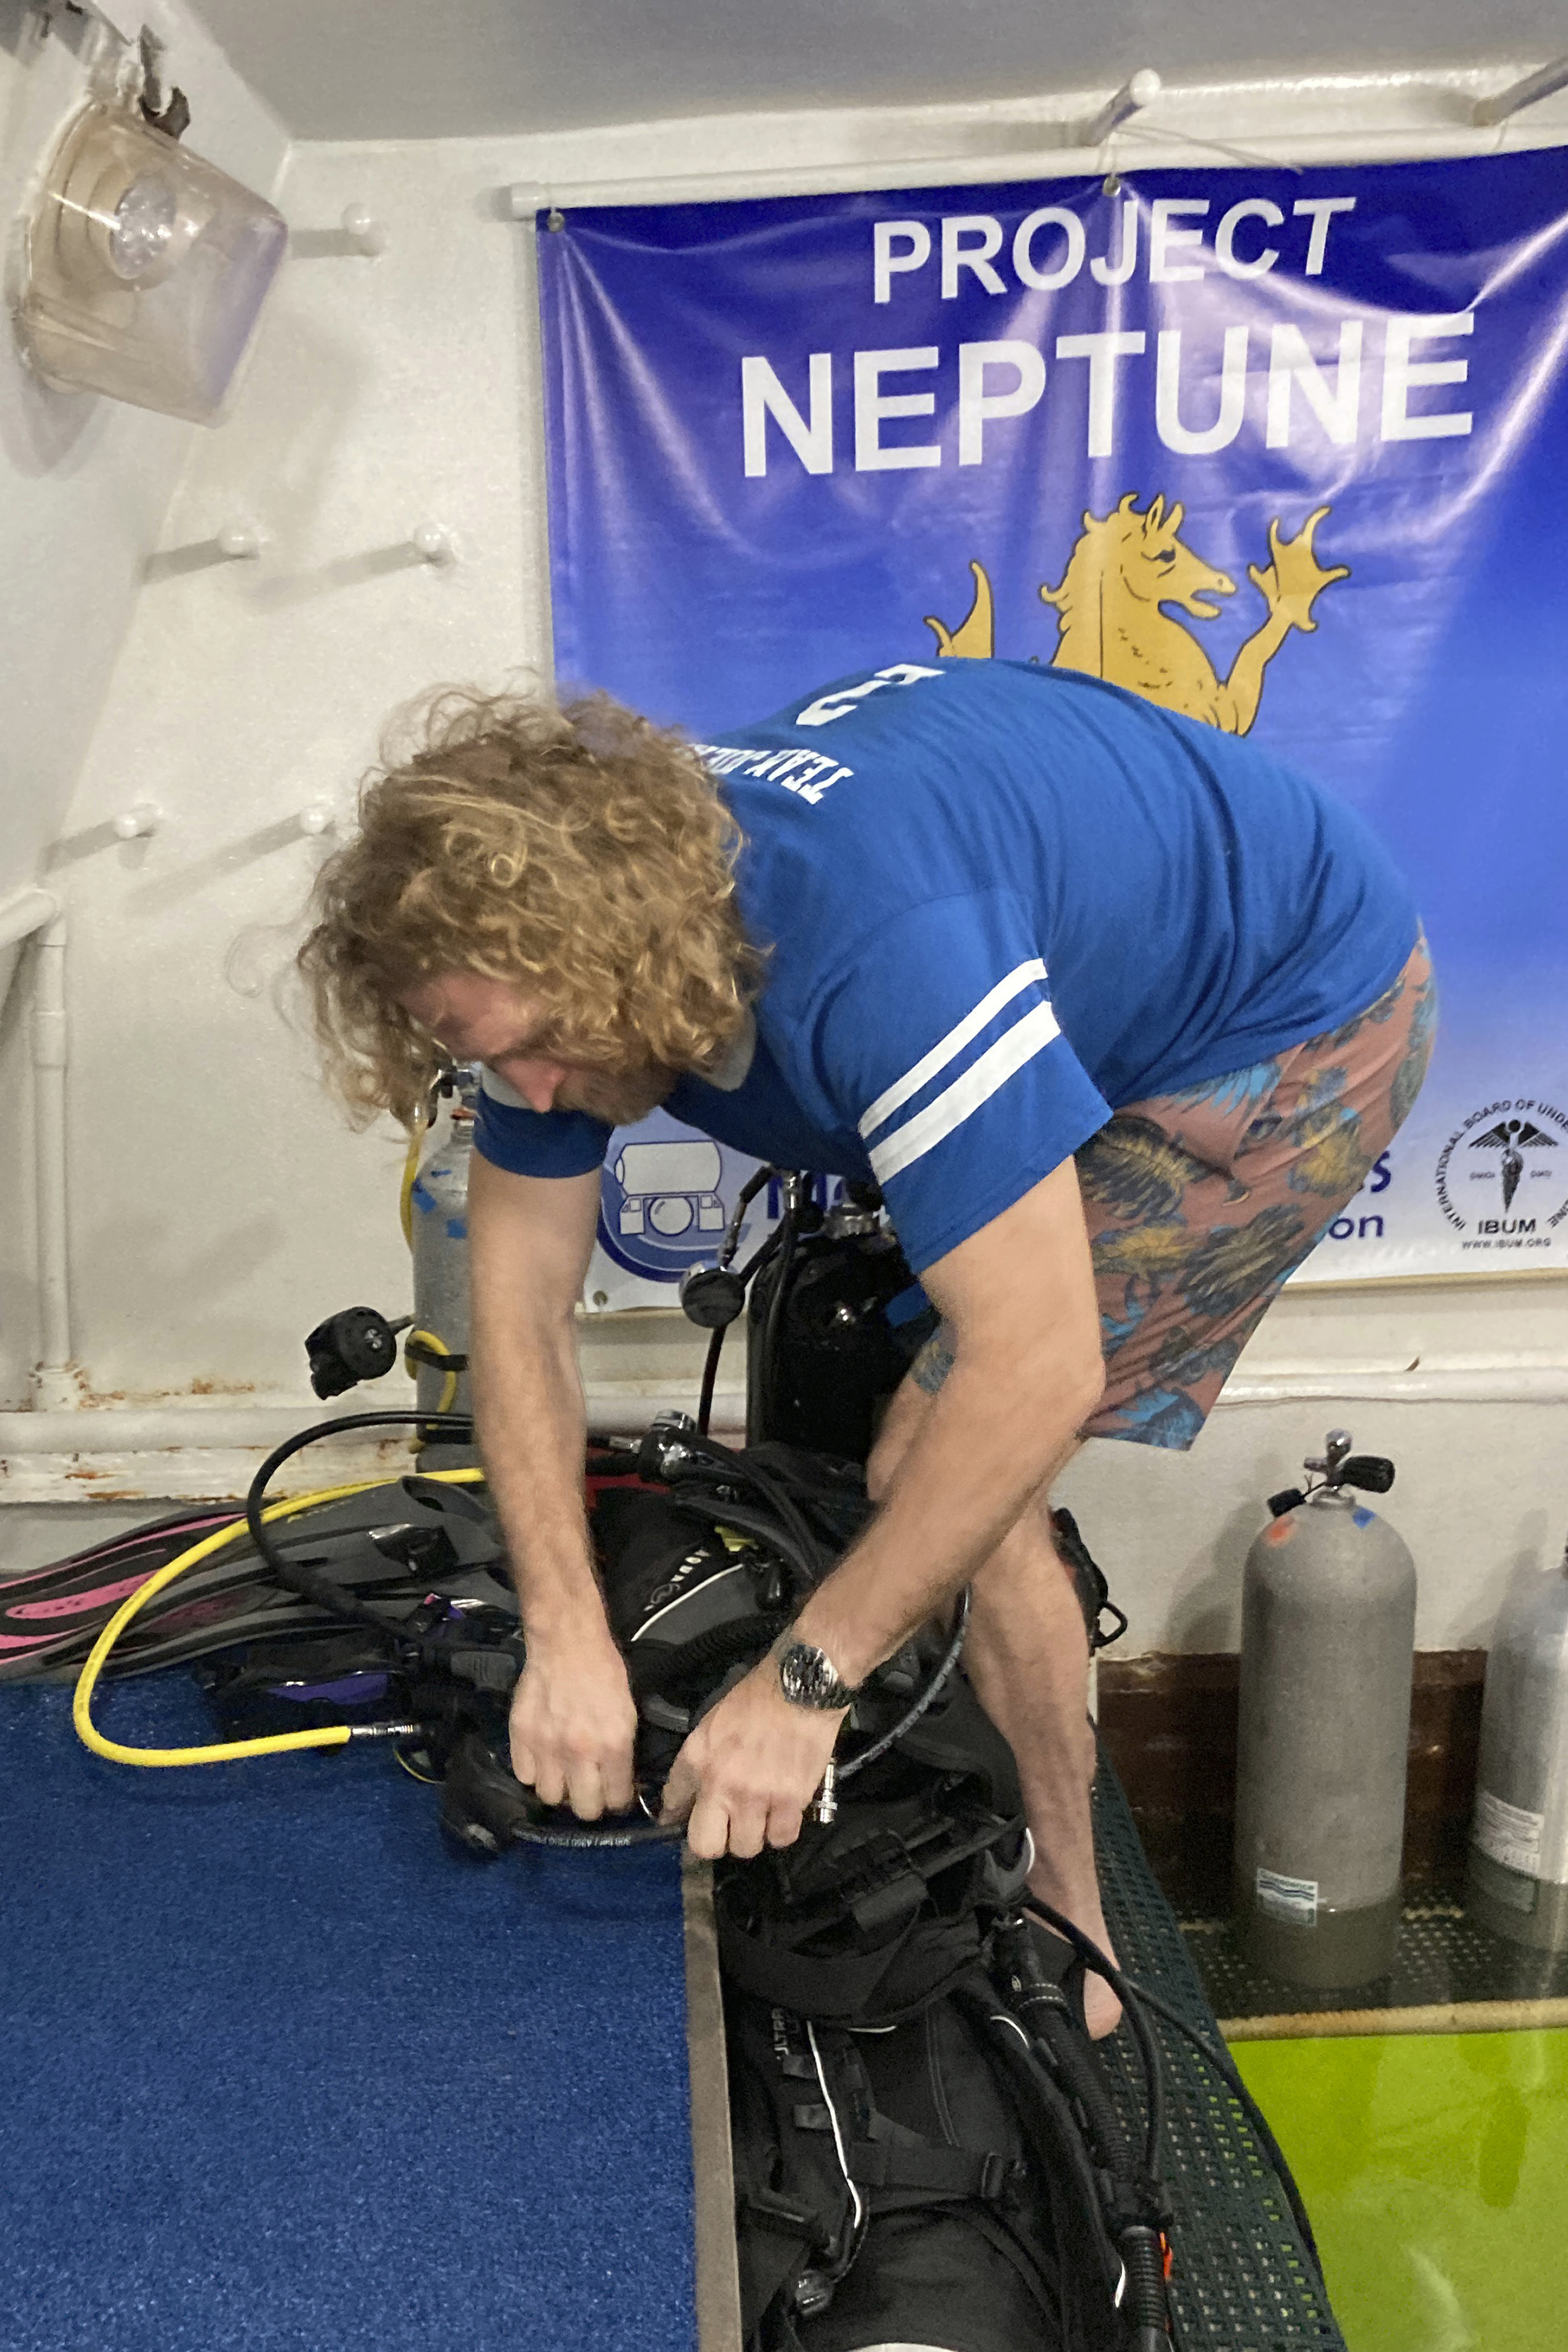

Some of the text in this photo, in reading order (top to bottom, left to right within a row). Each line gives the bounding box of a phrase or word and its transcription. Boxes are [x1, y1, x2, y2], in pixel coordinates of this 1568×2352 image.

[873, 197, 1356, 304] PROJECT
[741, 312, 1475, 478] NEPTUNE
[1435, 1131, 1467, 1231] INTERNATIONAL
[1463, 1100, 1512, 1131] BOARD
[1515, 1099, 1536, 1111] OF
[1462, 1238, 1551, 1250] WWW.IBUM.ORG
[1478, 1218, 1536, 1235] IBUM
